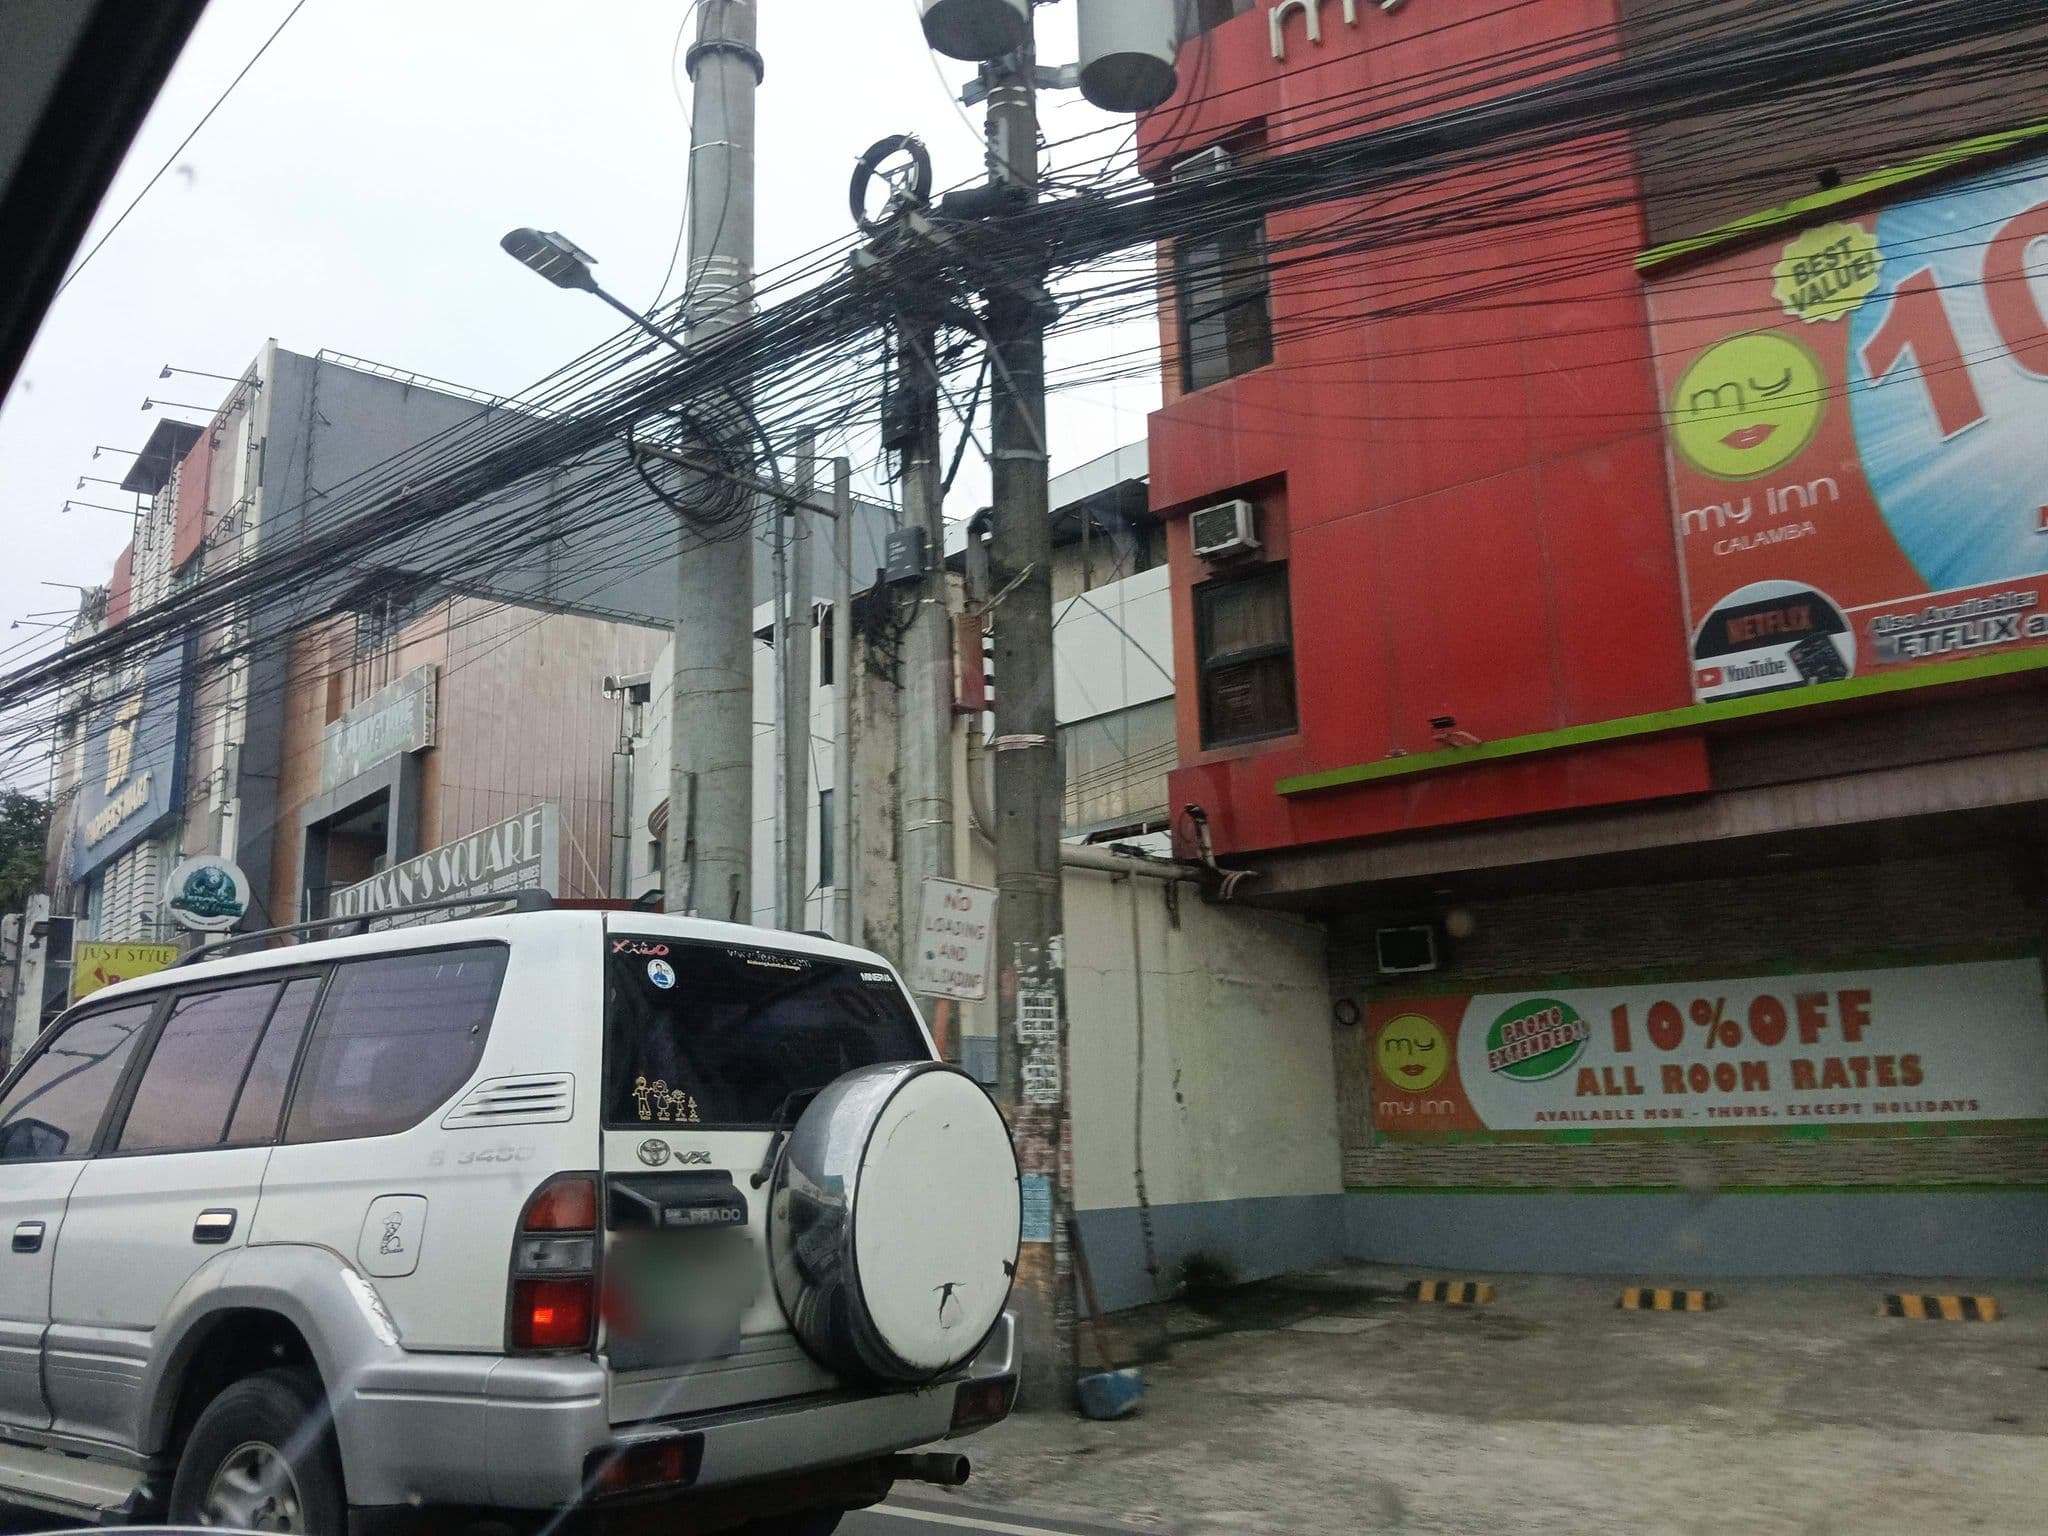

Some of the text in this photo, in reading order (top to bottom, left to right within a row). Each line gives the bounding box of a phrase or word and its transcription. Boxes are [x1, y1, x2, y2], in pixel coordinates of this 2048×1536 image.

[1268, 0, 1404, 59] m
[1792, 236, 1853, 287] BEST
[1789, 251, 1874, 312] VALUE!
[1680, 476, 1841, 536] my inn
[1712, 520, 1817, 556] CALAMBA
[1722, 657, 1788, 683] YouTube
[438, 811, 542, 893] SQUARE
[944, 894, 972, 911] NO
[926, 916, 985, 940] LOADING
[83, 947, 170, 965] JUST STYLE
[939, 943, 968, 961] AND
[1503, 1007, 1562, 1042] PROMO
[1576, 1053, 1924, 1097] ALL ROOM RATES
[1420, 1099, 1456, 1114] inn
[1535, 1109, 1635, 1122] AVAILABLE
[1786, 1103, 1862, 1117] EXCEPT
[1872, 1099, 1979, 1115] HOLIDAYS
[673, 1150, 713, 1165] VX
[690, 1207, 741, 1224] PRADO
